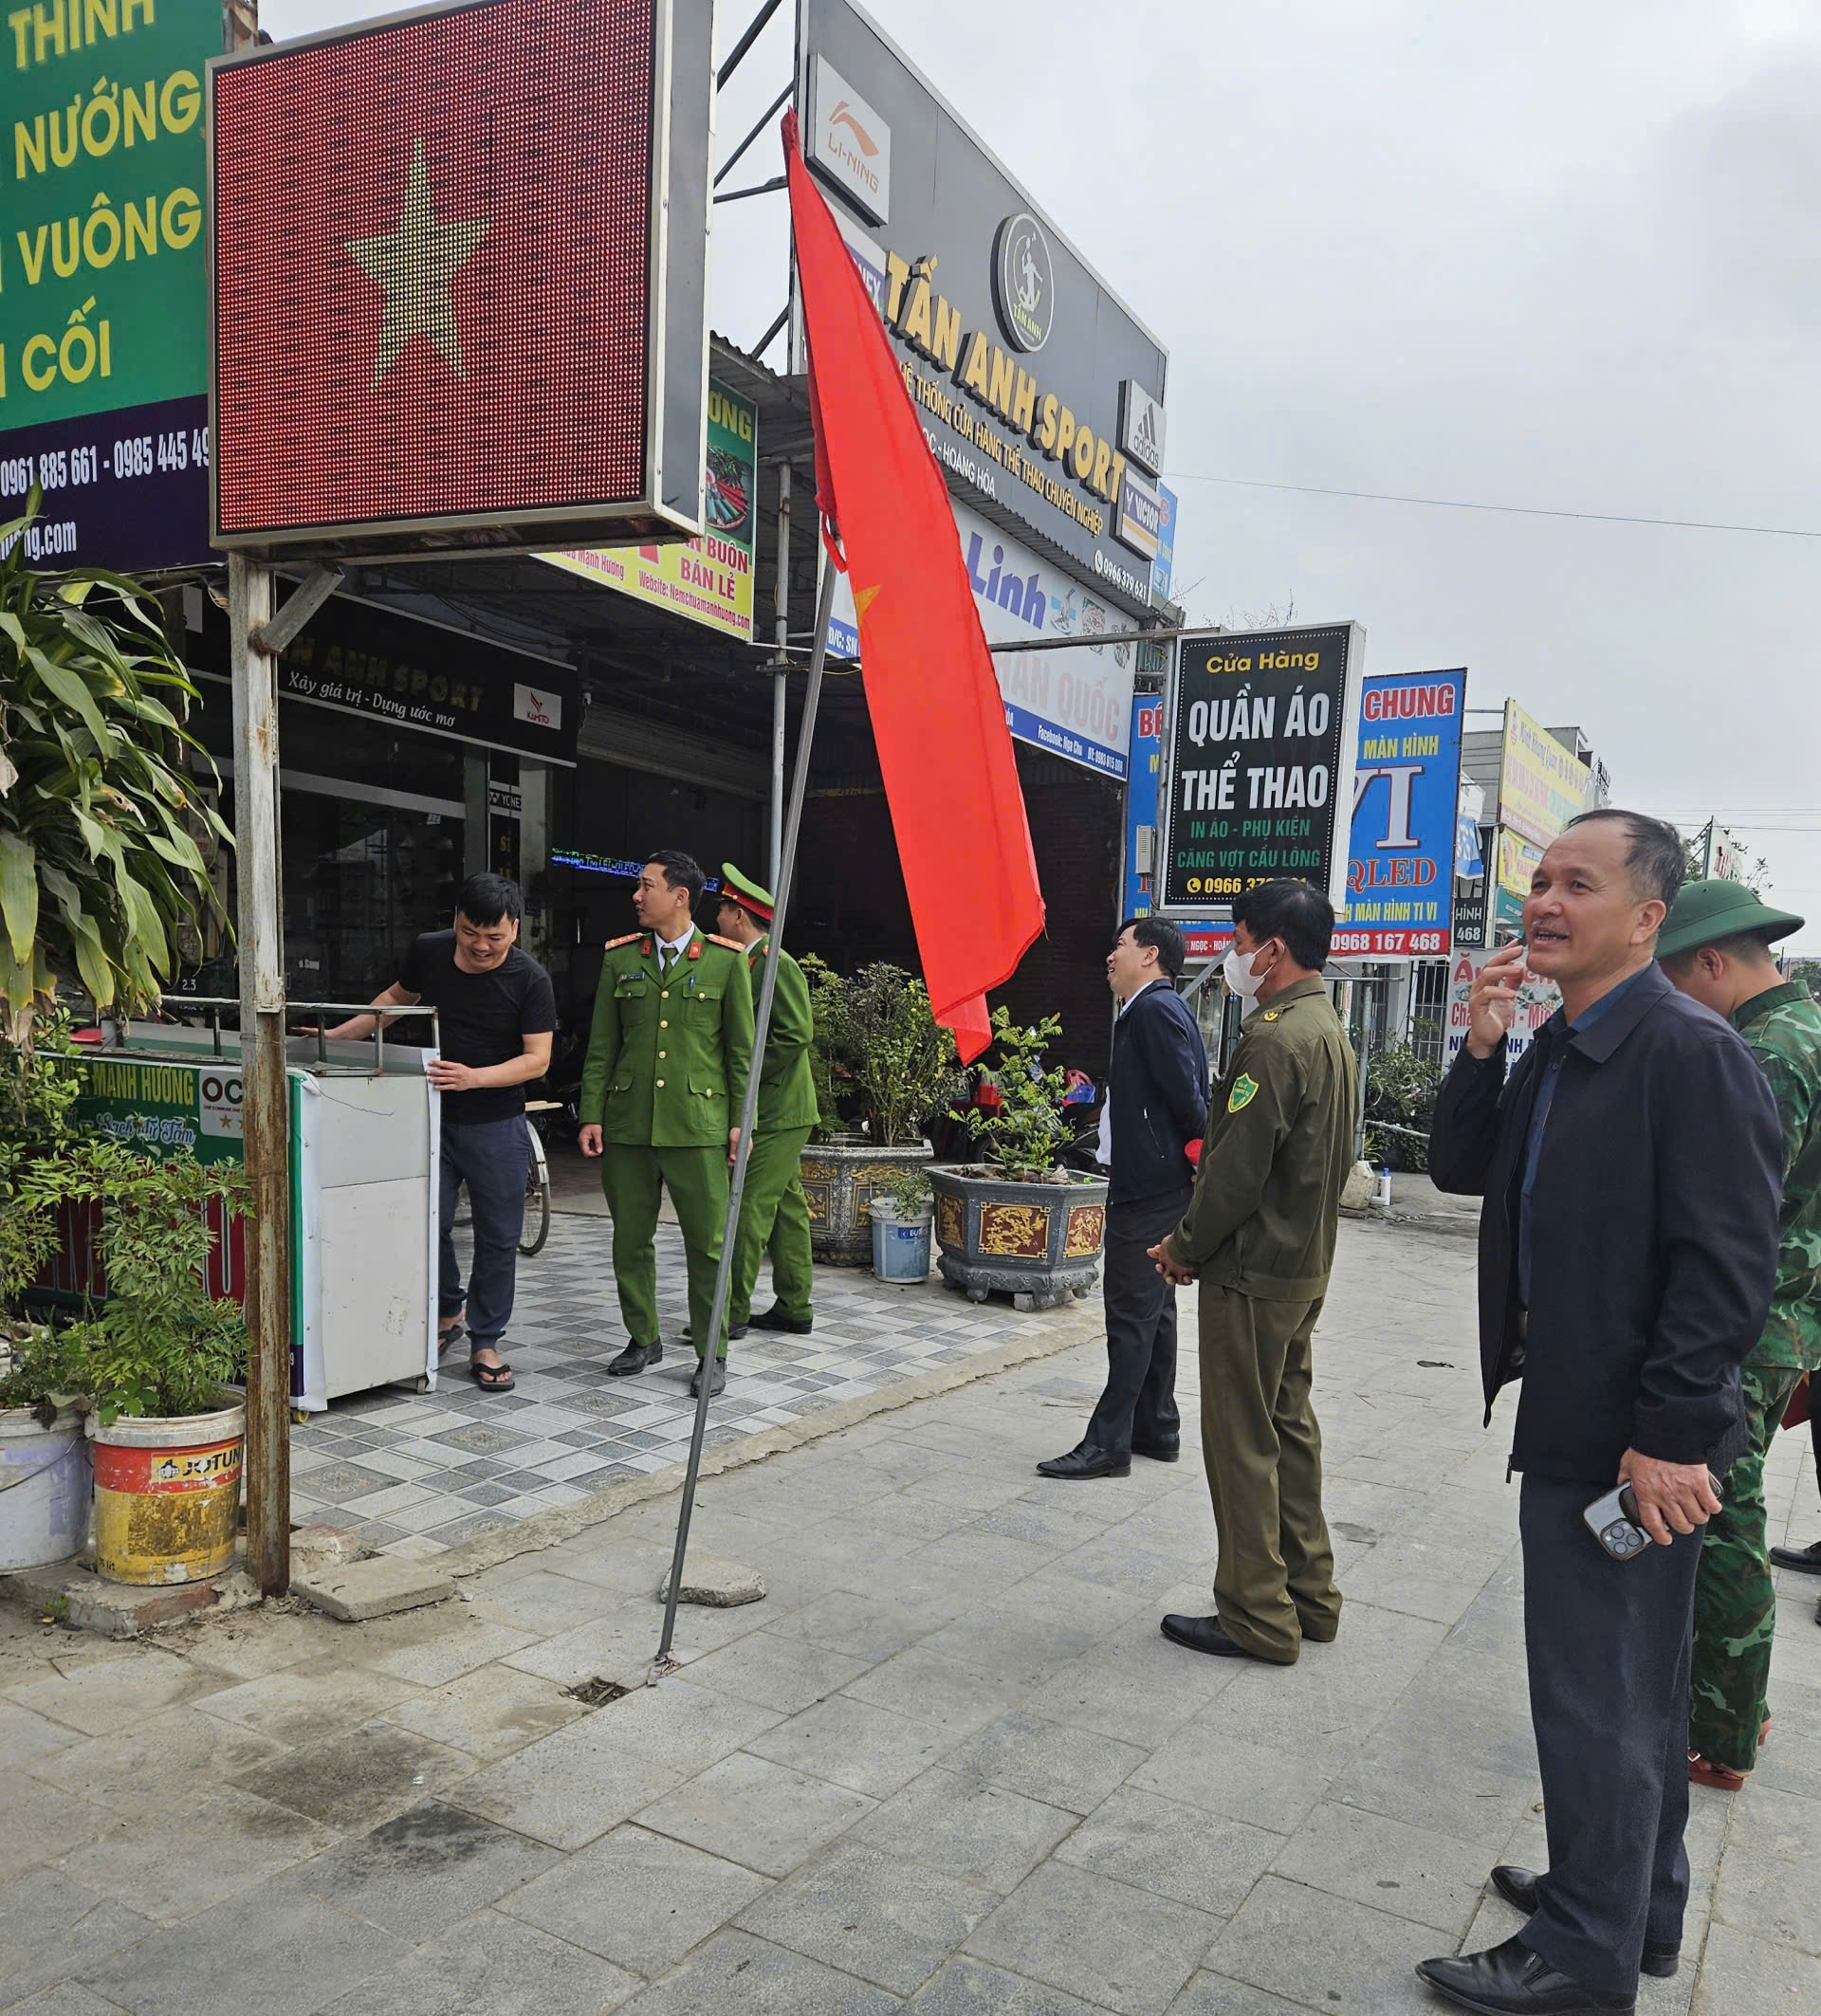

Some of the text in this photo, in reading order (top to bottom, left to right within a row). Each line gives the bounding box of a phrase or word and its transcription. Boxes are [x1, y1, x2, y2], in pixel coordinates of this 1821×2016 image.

[14, 70, 201, 179] NƯỚNG
[828, 133, 879, 193] LI-NING
[17, 188, 201, 284] VUÔNG
[22, 296, 111, 392] CỐI
[886, 250, 1126, 504] TẤN ANH SPORT
[1, 456, 34, 497] 0961
[39, 450, 66, 490] 885
[71, 446, 98, 486] 661
[114, 436, 153, 479] 0985
[157, 431, 188, 471] 445
[976, 421, 1002, 463] HÀNG
[1022, 458, 1044, 493] THAO
[1046, 478, 1076, 519] CHUYÊN
[1134, 434, 1158, 468] adidas
[977, 467, 995, 498] HÓA
[680, 557, 713, 592] BÁN
[706, 535, 749, 575] BUÔN
[638, 569, 669, 597] Website:
[966, 531, 1046, 631] Linh
[1103, 558, 1121, 584] 0966
[1134, 579, 1147, 600] 621
[1205, 651, 1319, 673] Cửa Hàng
[288, 671, 317, 695] Xây
[319, 683, 342, 699] giá
[373, 693, 407, 719] Dựng
[410, 706, 432, 722] ước
[435, 713, 455, 727] mơ
[1188, 683, 1330, 747] QUẦN ÁO
[1363, 683, 1455, 722] CHUNG
[1364, 732, 1439, 759] MÀN HÌNH
[1181, 751, 1329, 811] THỂ THAO
[1190, 820, 1205, 838] IN
[1209, 817, 1229, 838] ÁO
[1242, 819, 1271, 840] PHỤ
[1275, 816, 1311, 840] KIỆN
[1177, 848, 1215, 868] CĂNG
[1219, 849, 1245, 871] VỢT
[1281, 846, 1320, 867] LÔNG
[1347, 857, 1437, 893] QLED
[1205, 877, 1242, 893] 0966
[1354, 899, 1381, 922] MÀN
[1384, 898, 1410, 922] HÌNH
[1414, 902, 1425, 921] TI
[1426, 902, 1438, 921] VI
[1455, 904, 1481, 921] HÌNH
[1331, 933, 1370, 951] 0968
[1375, 933, 1406, 951] 167
[1409, 933, 1441, 951] 468
[1456, 926, 1481, 941] 468
[93, 1063, 137, 1106] MẠNH
[142, 1064, 194, 1106] HƯƠNG
